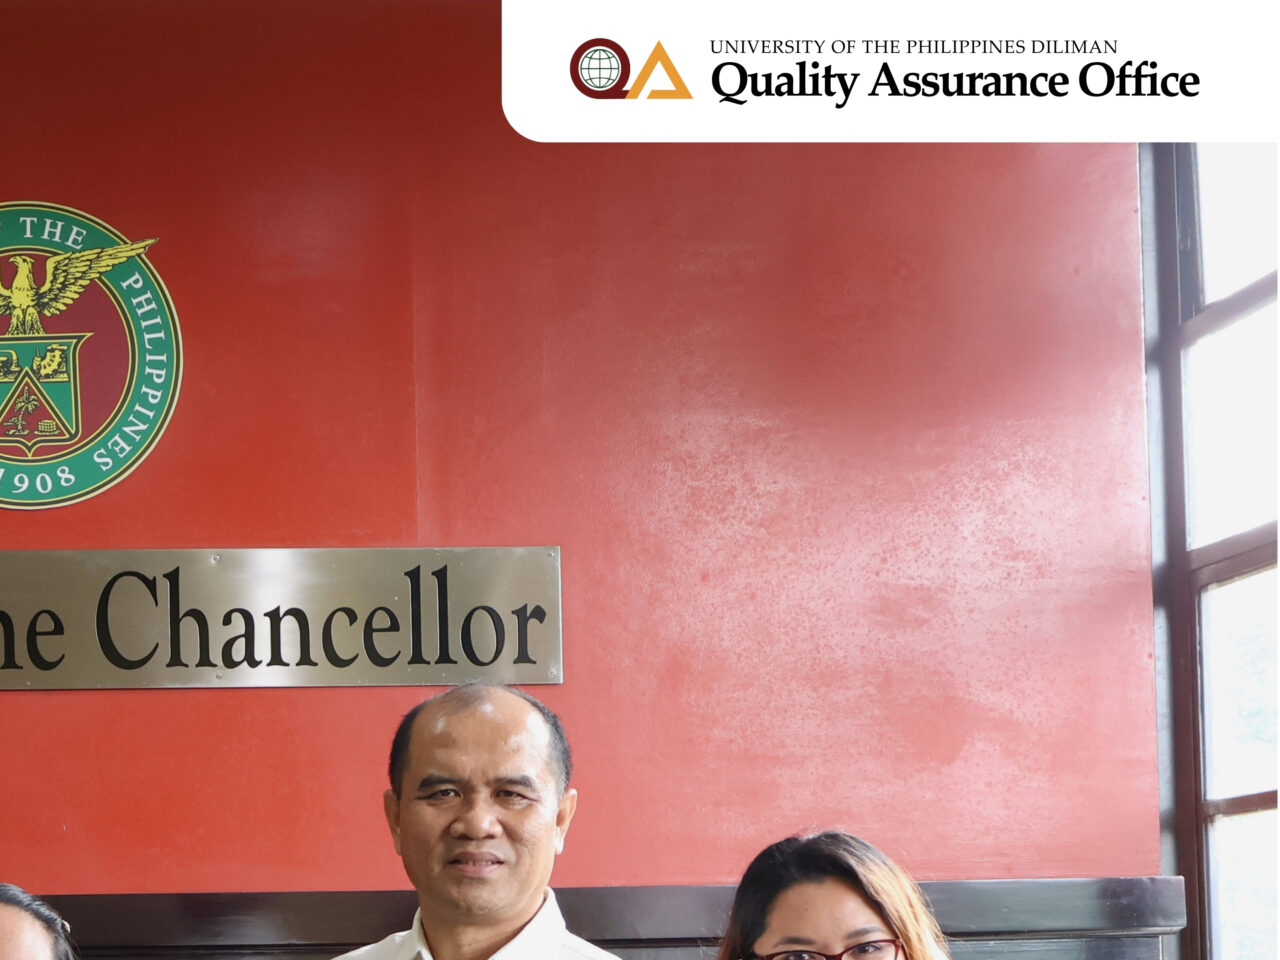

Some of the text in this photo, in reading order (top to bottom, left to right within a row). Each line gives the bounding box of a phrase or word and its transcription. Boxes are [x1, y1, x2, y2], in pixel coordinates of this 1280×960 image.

[19, 216, 88, 250] THE
[91, 270, 167, 472] PHILIPPINES
[96, 564, 547, 671] Chancellor
